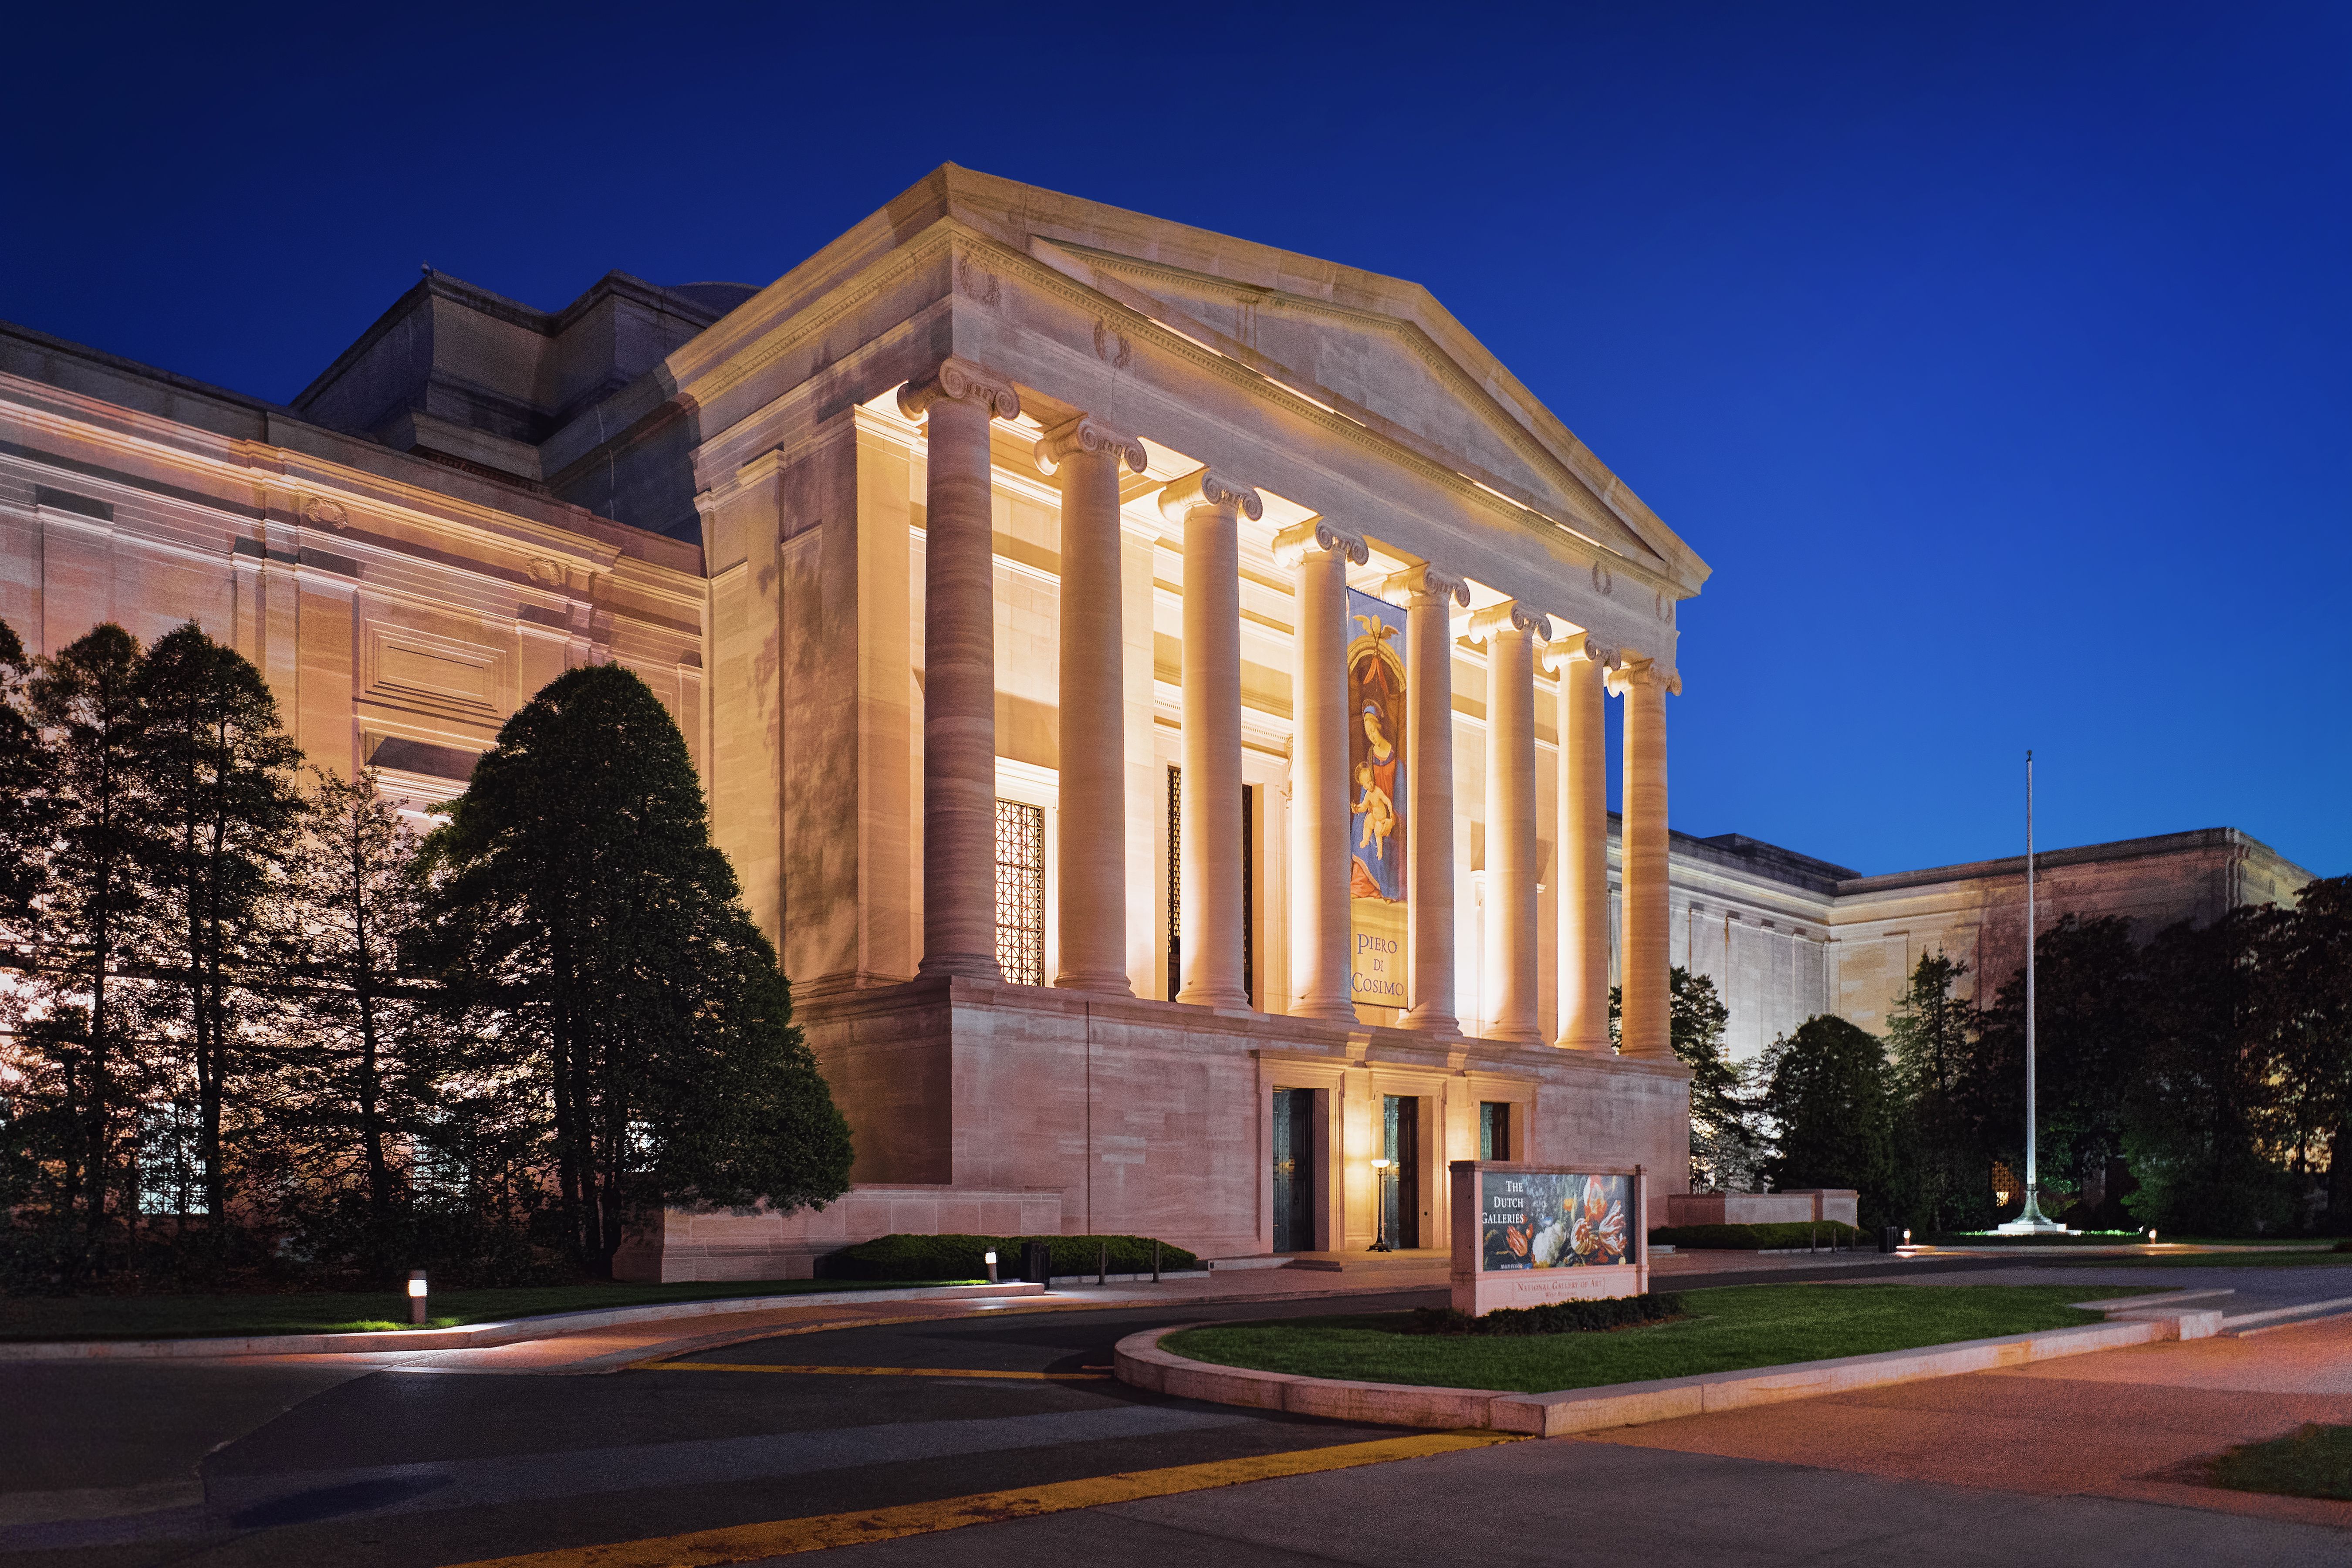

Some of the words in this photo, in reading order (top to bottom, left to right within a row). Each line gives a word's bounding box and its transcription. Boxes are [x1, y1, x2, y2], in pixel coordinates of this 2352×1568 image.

[1357, 934, 1397, 954] PIERO
[1373, 959, 1384, 972] DI
[1352, 972, 1404, 996] COSIMO
[1505, 1180, 1523, 1192] THE
[1494, 1196, 1524, 1208] DUTCH
[1482, 1212, 1524, 1224] GALLERIES
[1517, 1282, 1550, 1292] NATIONAL
[1552, 1280, 1578, 1290] GALLERY
[1591, 1279, 1602, 1288] ART
